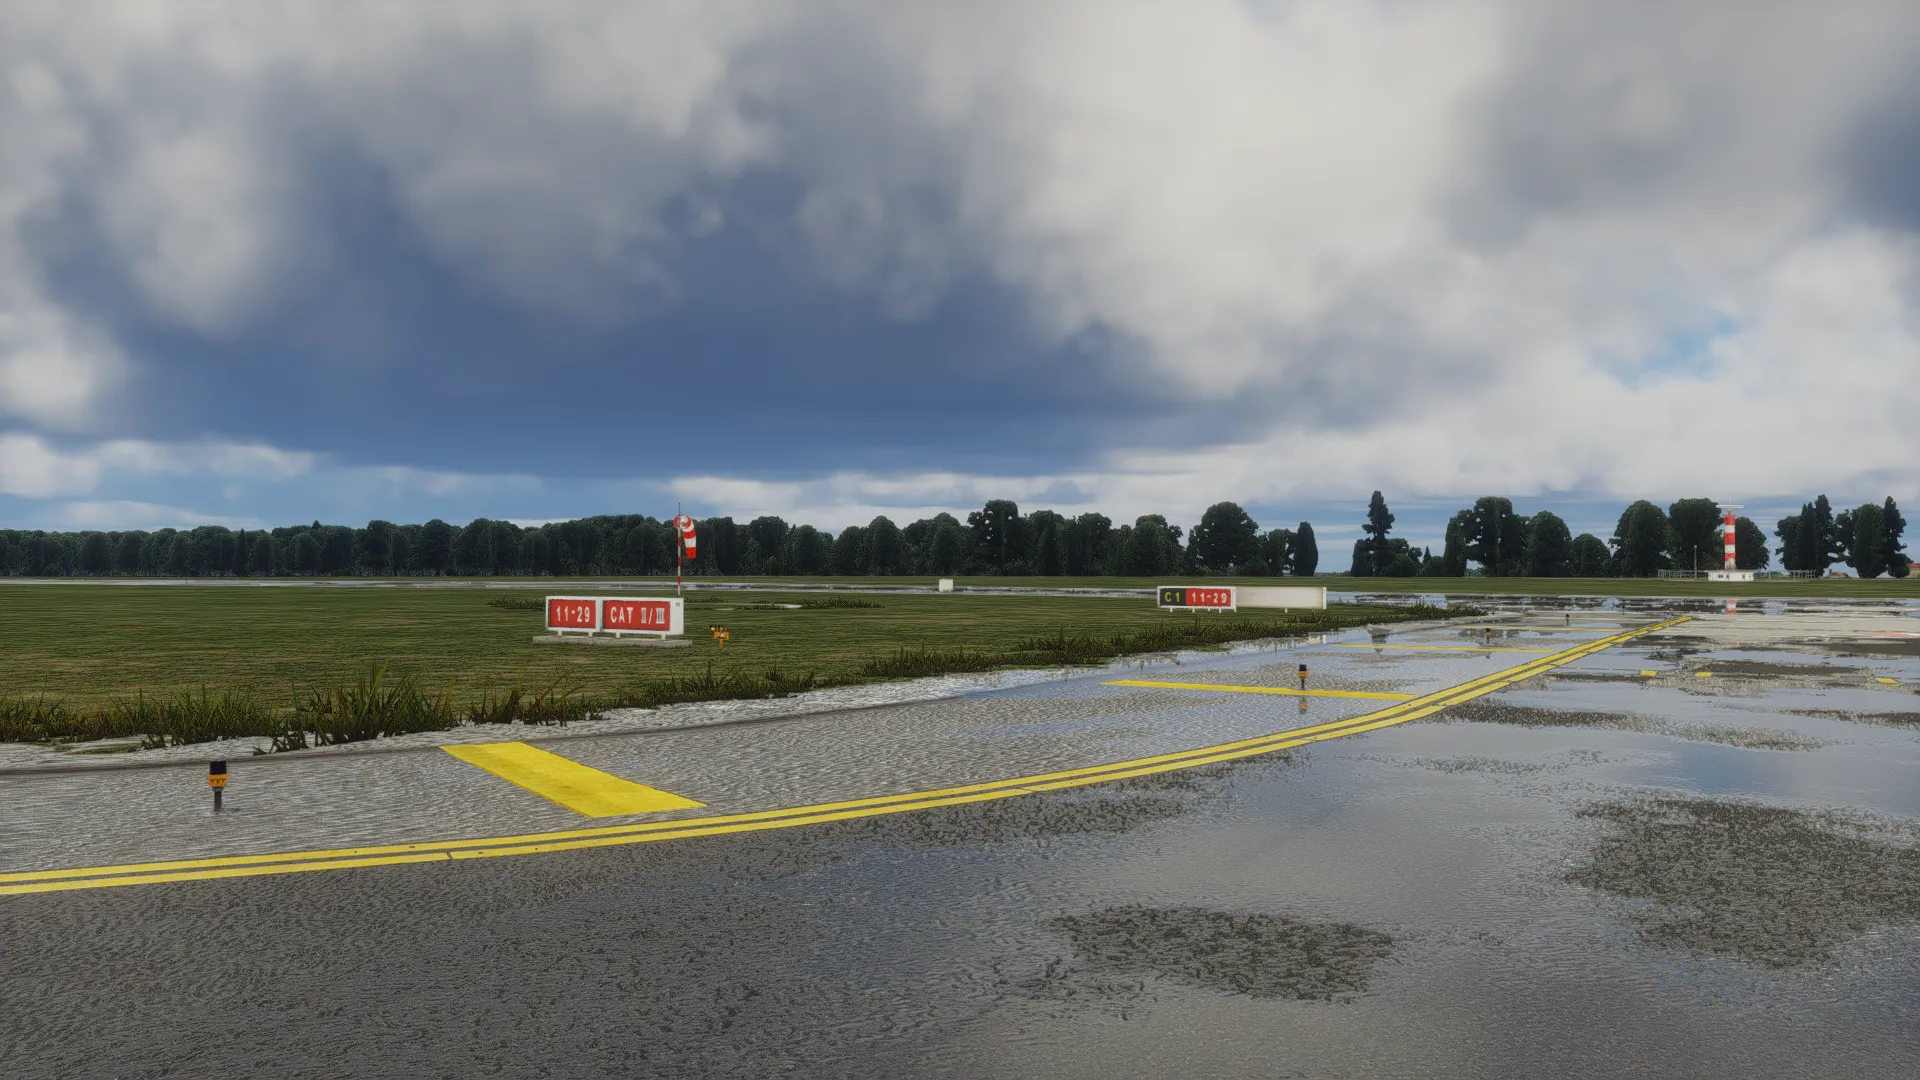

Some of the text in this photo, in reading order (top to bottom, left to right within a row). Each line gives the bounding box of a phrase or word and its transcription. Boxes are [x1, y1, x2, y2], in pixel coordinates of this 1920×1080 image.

[1164, 591, 1180, 603] C1
[1191, 591, 1227, 604] 11-29
[556, 605, 590, 623] 11-29
[610, 606, 634, 624] CAT
